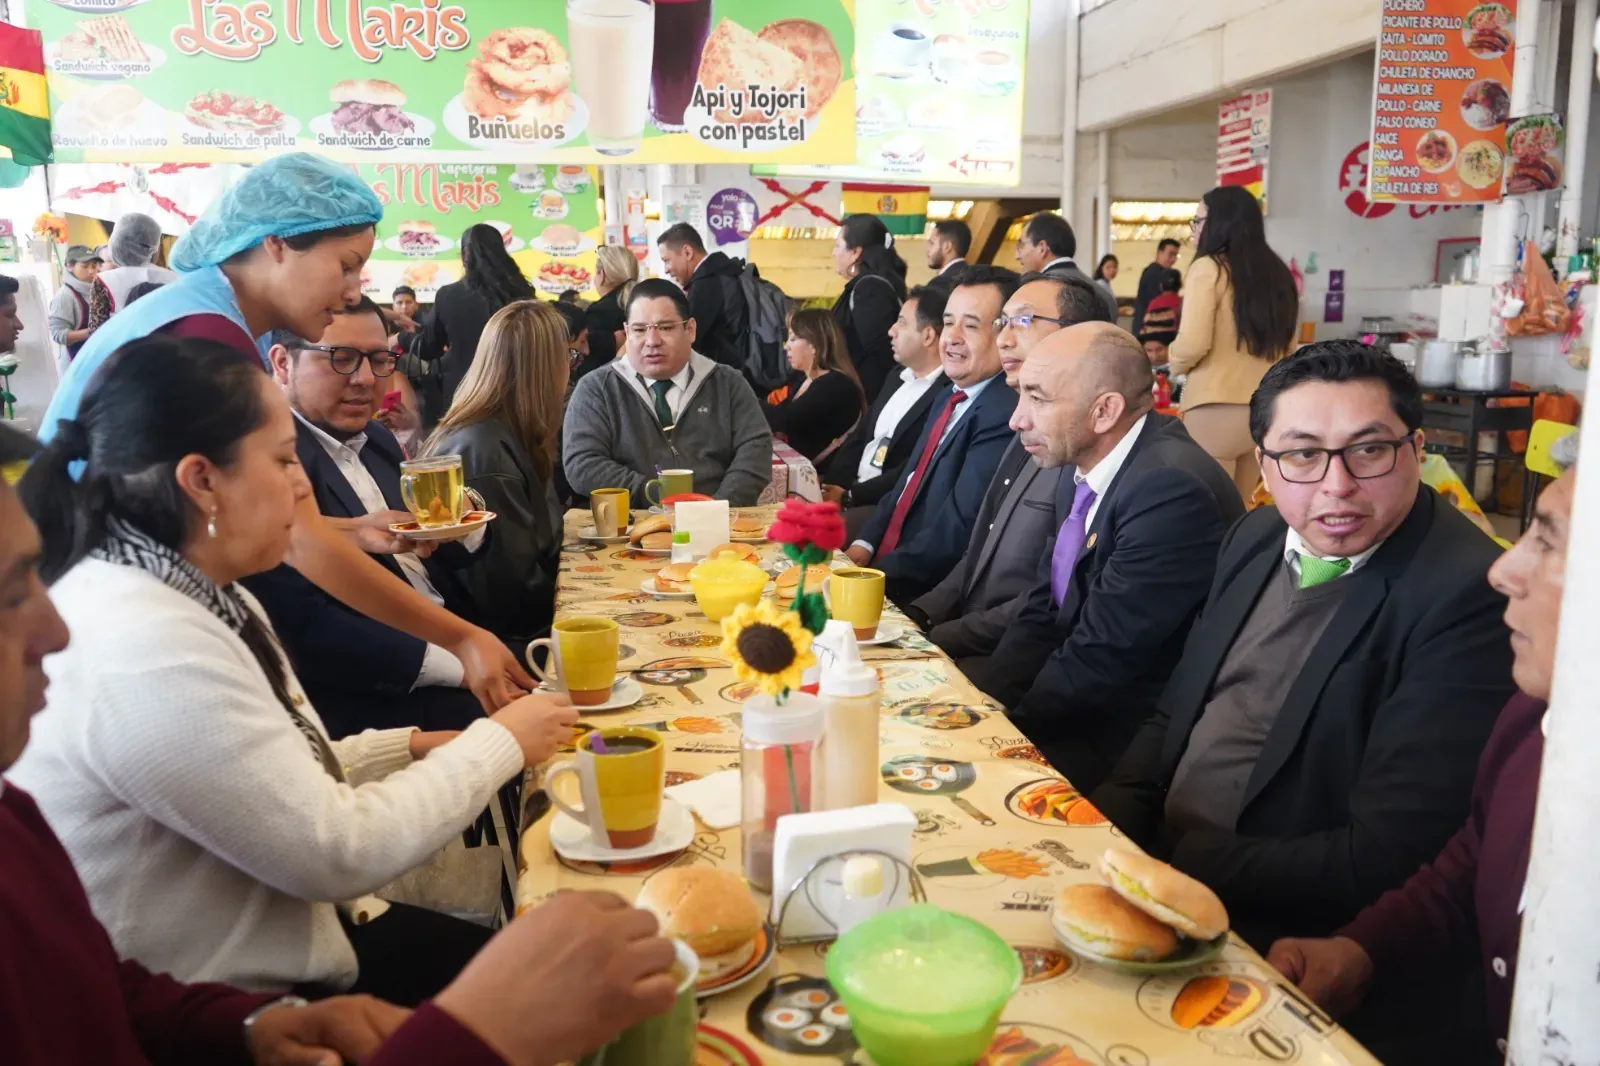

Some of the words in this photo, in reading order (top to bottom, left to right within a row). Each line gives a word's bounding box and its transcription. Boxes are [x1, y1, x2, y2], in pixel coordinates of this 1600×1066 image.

[1382, 16, 1419, 28] PICANTE
[1420, 17, 1432, 28] DE
[1433, 17, 1462, 29] POLLO
[1380, 49, 1409, 61] POLLO
[1411, 50, 1448, 62] DORADO
[55, 60, 108, 71] Sandwich
[111, 62, 151, 75] vegano
[1379, 66, 1418, 78] CHULETA
[1419, 67, 1432, 79] DE
[1432, 67, 1476, 79] CHANCHO
[1378, 82, 1420, 95] MILANESA
[1421, 83, 1434, 95] DE
[692, 86, 725, 117] Api
[731, 92, 744, 115] y
[748, 86, 806, 118] Tojori
[1377, 99, 1406, 112] POLLO
[1412, 100, 1442, 112] CARNE
[468, 114, 566, 140] Buñuelos
[1376, 116, 1403, 128] FALSO
[182, 133, 241, 146] Sandwich
[246, 133, 262, 146] de
[263, 132, 296, 147] palta
[317, 132, 374, 147] Sandwich
[379, 132, 393, 147] de
[396, 136, 431, 147] carne
[699, 126, 736, 141] con
[742, 119, 806, 148] pastel
[1375, 132, 1399, 145] SAICE
[1372, 181, 1409, 194] CHULETA
[1410, 182, 1423, 194] DE
[1423, 182, 1439, 194] RES
[709, 214, 734, 230] QR
